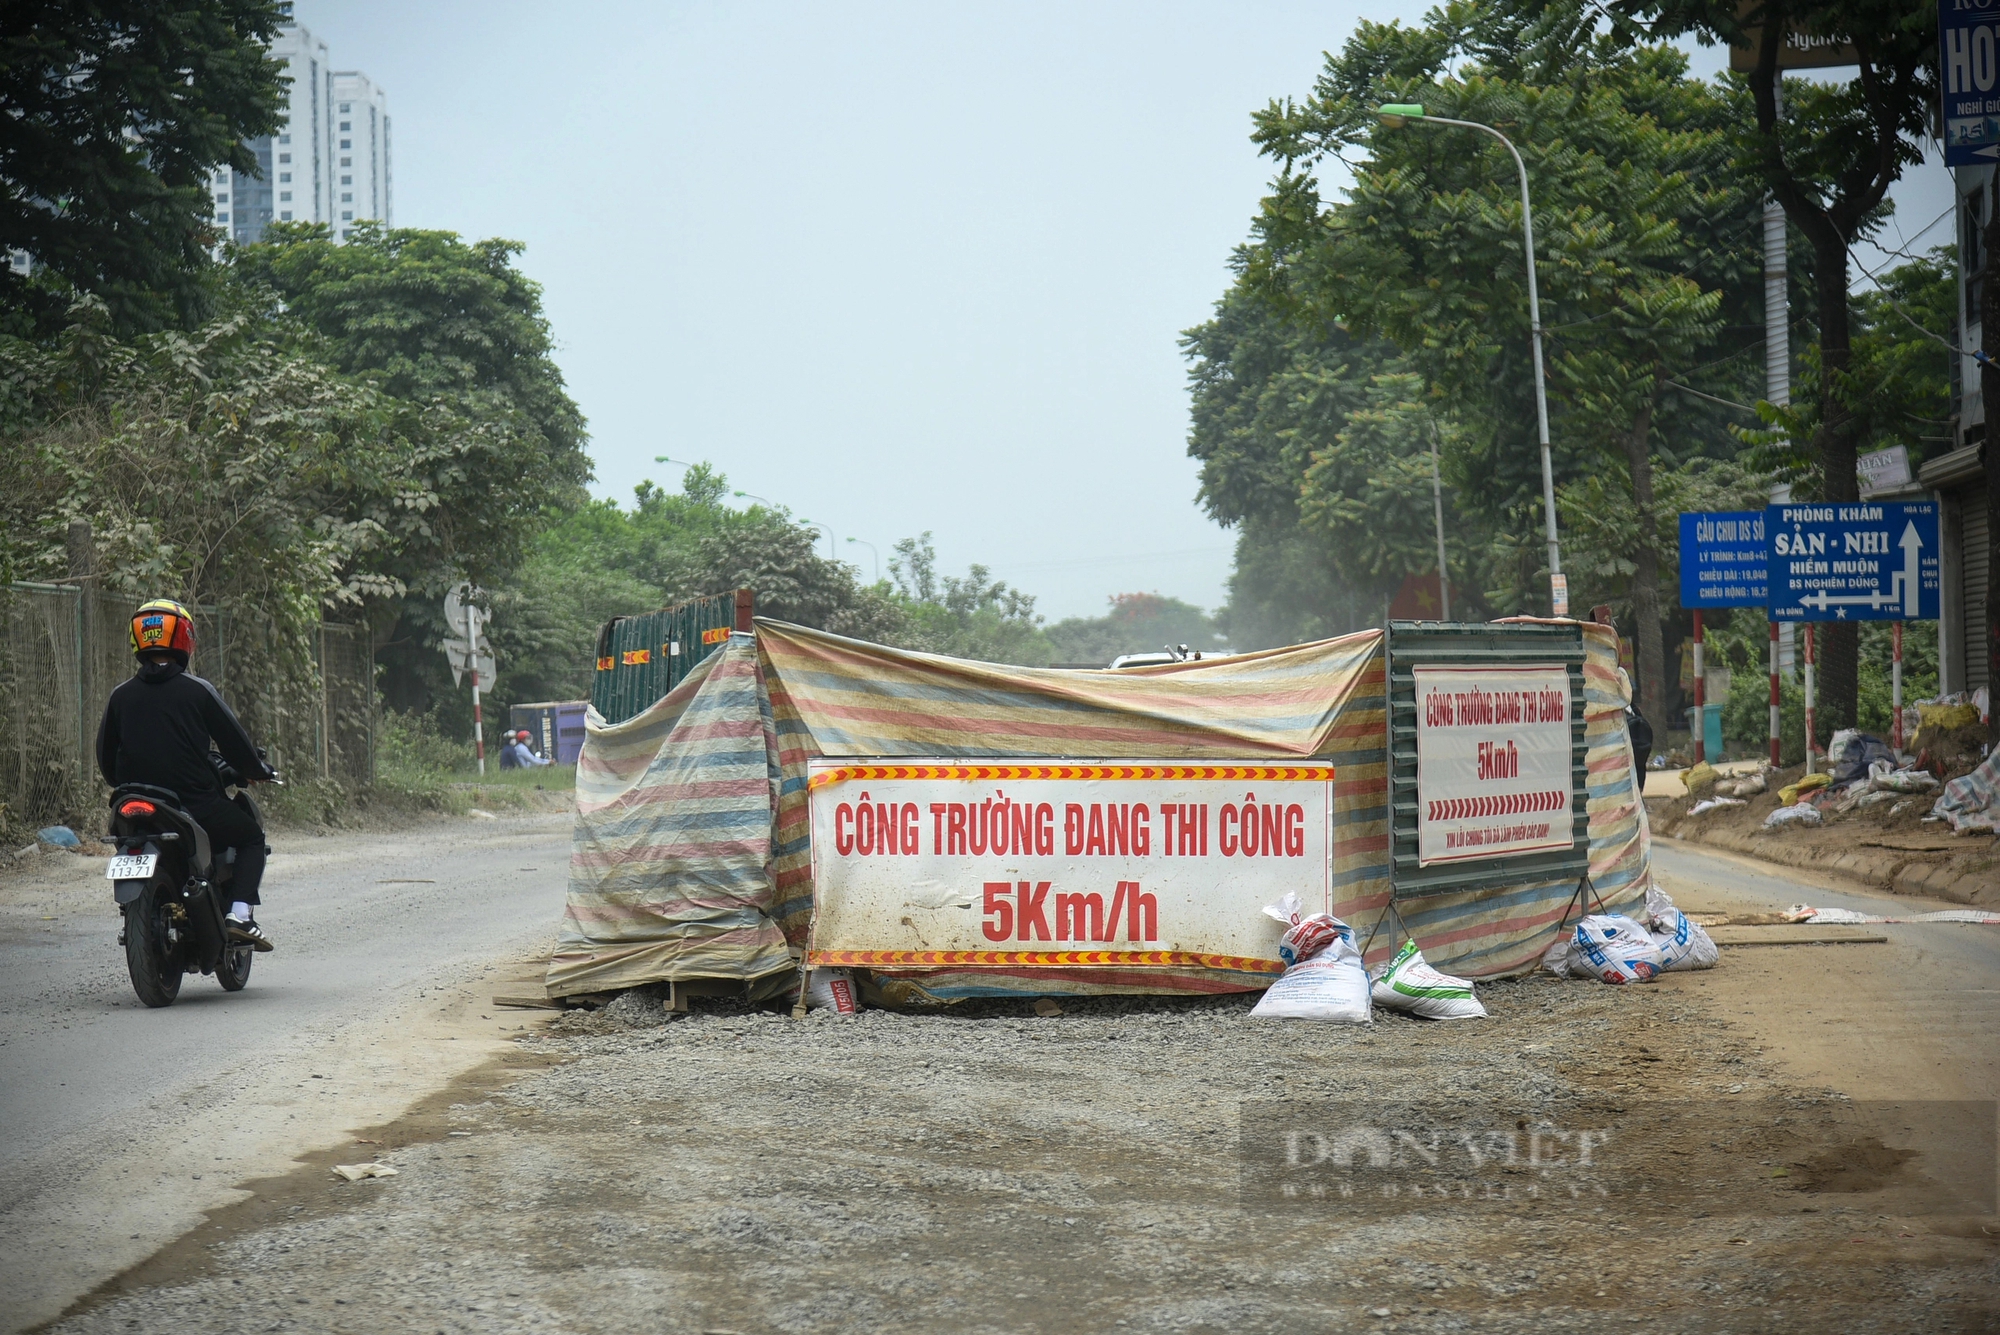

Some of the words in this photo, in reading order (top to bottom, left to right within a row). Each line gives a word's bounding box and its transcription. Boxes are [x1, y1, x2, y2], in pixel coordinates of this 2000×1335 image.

[1782, 505, 1835, 523] PHÒNG
[1838, 504, 1884, 522] KHÁM
[1696, 514, 1715, 543] CẦU
[1716, 520, 1737, 542] CHUI
[1739, 520, 1751, 542] DS
[1752, 512, 1765, 542] SỐ
[1775, 523, 1826, 556] SẢN
[1843, 531, 1890, 555] NHI
[1790, 557, 1828, 575] HIẾM
[1832, 558, 1880, 576] MUỘN
[1789, 578, 1803, 590] BS
[1804, 576, 1846, 590] NGHIÊM
[142, 615, 163, 628] THE
[143, 628, 163, 643] JOE
[1426, 686, 1453, 728] CÔNG
[1455, 684, 1493, 726] TRƯỜNG
[1495, 691, 1521, 725] ĐANG
[1522, 691, 1537, 724] THI
[1539, 684, 1563, 723] CÔNG
[1477, 740, 1519, 781] 5Km/h
[834, 791, 920, 857] CÔNG
[929, 789, 1054, 857] TRƯỜNG
[1063, 802, 1150, 857] ĐANG
[1160, 802, 1208, 857] THI
[1218, 792, 1305, 857] CÔNG
[115, 855, 150, 867] 29-B2
[111, 866, 150, 878] 113.71
[981, 880, 1159, 943] 5Km/h
